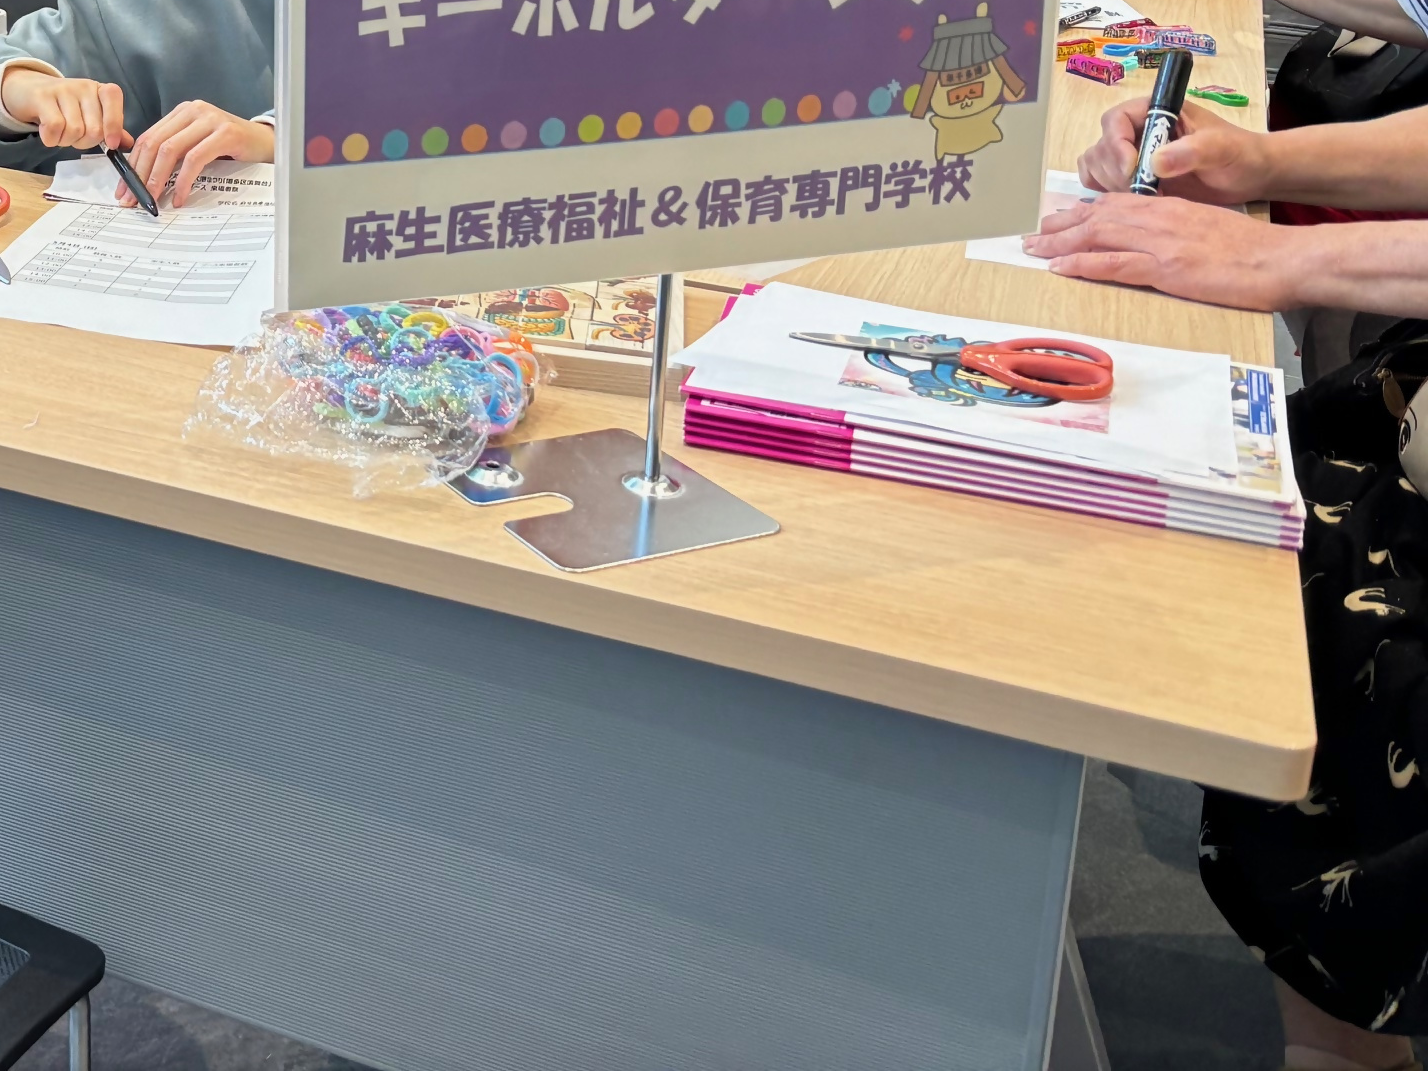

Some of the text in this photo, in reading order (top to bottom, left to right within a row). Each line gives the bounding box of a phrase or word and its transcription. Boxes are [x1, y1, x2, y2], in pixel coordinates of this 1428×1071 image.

[341, 155, 974, 265] 麻生医療福祉&保育専門学校
